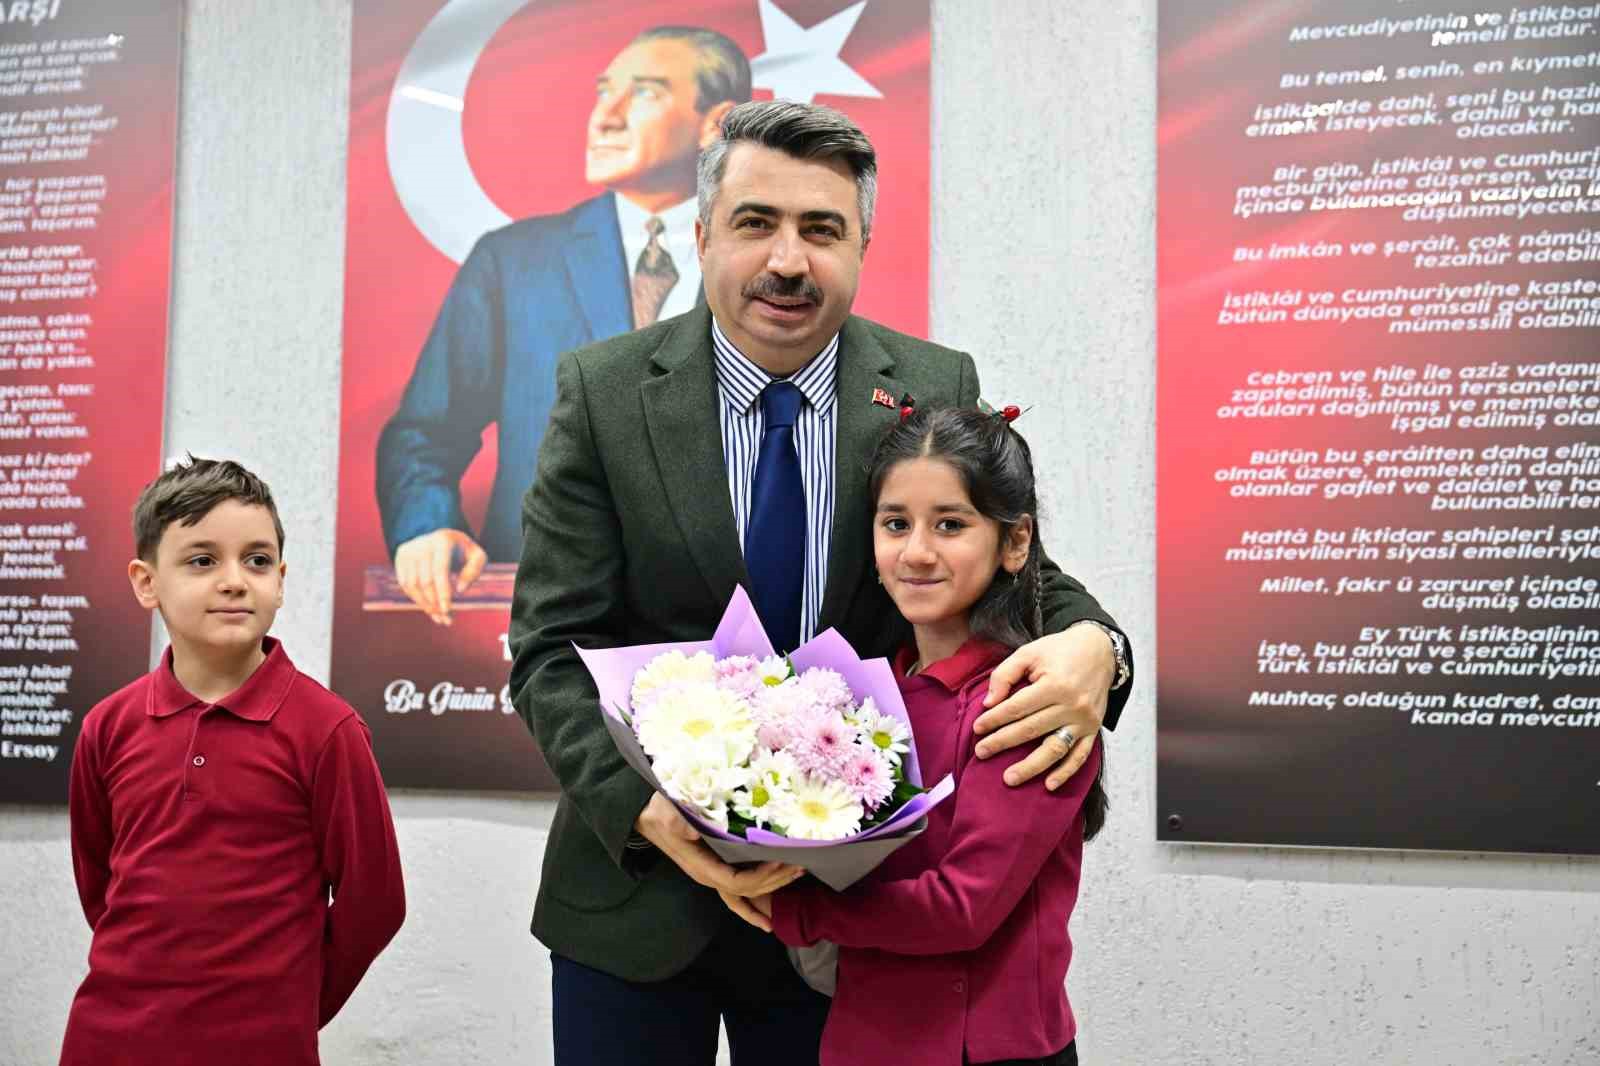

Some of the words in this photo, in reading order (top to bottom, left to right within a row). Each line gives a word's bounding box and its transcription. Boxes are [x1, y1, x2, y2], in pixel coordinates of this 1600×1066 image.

[1289, 12, 1468, 41] Mevcudiyetinin
[1474, 13, 1502, 26] ve
[1431, 25, 1508, 46] temeli
[1514, 22, 1597, 39] budur.
[1280, 74, 1310, 88] Bu
[1473, 60, 1504, 74] en
[1446, 88, 1497, 107] seni
[1503, 88, 1535, 104] bu
[1246, 118, 1319, 137] etmek
[1528, 105, 1555, 118] ve
[1456, 119, 1574, 139] olacaktır.
[1273, 164, 1307, 181] Bir
[1459, 156, 1487, 170] ve
[1236, 176, 1408, 199] mecburiyetine
[1233, 198, 1304, 218] içinde
[1470, 179, 1582, 201] vaziyetin
[1233, 247, 1263, 261] Bu
[1350, 242, 1376, 255] ve
[1468, 233, 1512, 251] çok
[1414, 251, 1512, 268] tezahür
[1308, 292, 1335, 305] ve
[1343, 281, 1520, 303] Cumhuriyetine
[1218, 309, 1287, 325] bütün
[1294, 303, 1403, 323] dünyada
[1410, 297, 1492, 316] emsali
[1247, 370, 1332, 385] Cebren
[1340, 370, 1366, 382] ve
[1373, 364, 1416, 382] hile
[1423, 363, 1452, 380] ile
[1459, 362, 1509, 379] aziz
[1380, 379, 1453, 397] bütün
[1217, 402, 1316, 418] orduları
[1449, 400, 1476, 412] ve
[1392, 413, 1452, 433] işgal
[1458, 411, 1546, 431] edilmiş
[1250, 449, 1319, 465] Bütün
[1325, 449, 1357, 463] bu
[1481, 444, 1548, 461] daha
[1214, 465, 1288, 482] olmak
[1375, 460, 1522, 479] memleketin
[1230, 483, 1318, 497] olanlar
[1324, 478, 1397, 499] gaflet
[1403, 480, 1431, 494] ve
[1535, 481, 1562, 493] ve
[1314, 529, 1346, 544] bu
[1352, 528, 1436, 544] iktidar
[1442, 525, 1554, 545] sahipleri
[1225, 545, 1380, 561] müstevlilerin
[1386, 543, 1457, 563] siyasi
[1335, 577, 1391, 596] fakr
[1397, 577, 1413, 592] ü
[1418, 577, 1515, 592] zaruret
[1520, 575, 1598, 595] içinde
[1422, 593, 1519, 613] düşmüş
[1360, 627, 1391, 644] Ey
[1398, 626, 1452, 642] Türk
[1459, 625, 1600, 642] istikbalinin
[1314, 642, 1347, 657] bu
[1352, 643, 1421, 658] ahval
[1428, 645, 1456, 658] ve
[1258, 658, 1310, 674] Türk
[1405, 661, 1433, 674] ve
[384, 679, 425, 714] Bu
[428, 681, 496, 715] Günün
[1248, 691, 1337, 710] Muhtaç
[1343, 691, 1447, 711] olduğun
[1452, 692, 1544, 711] kudret,
[1411, 709, 1494, 725] kanda
[1, 740, 59, 762] Ersoy
